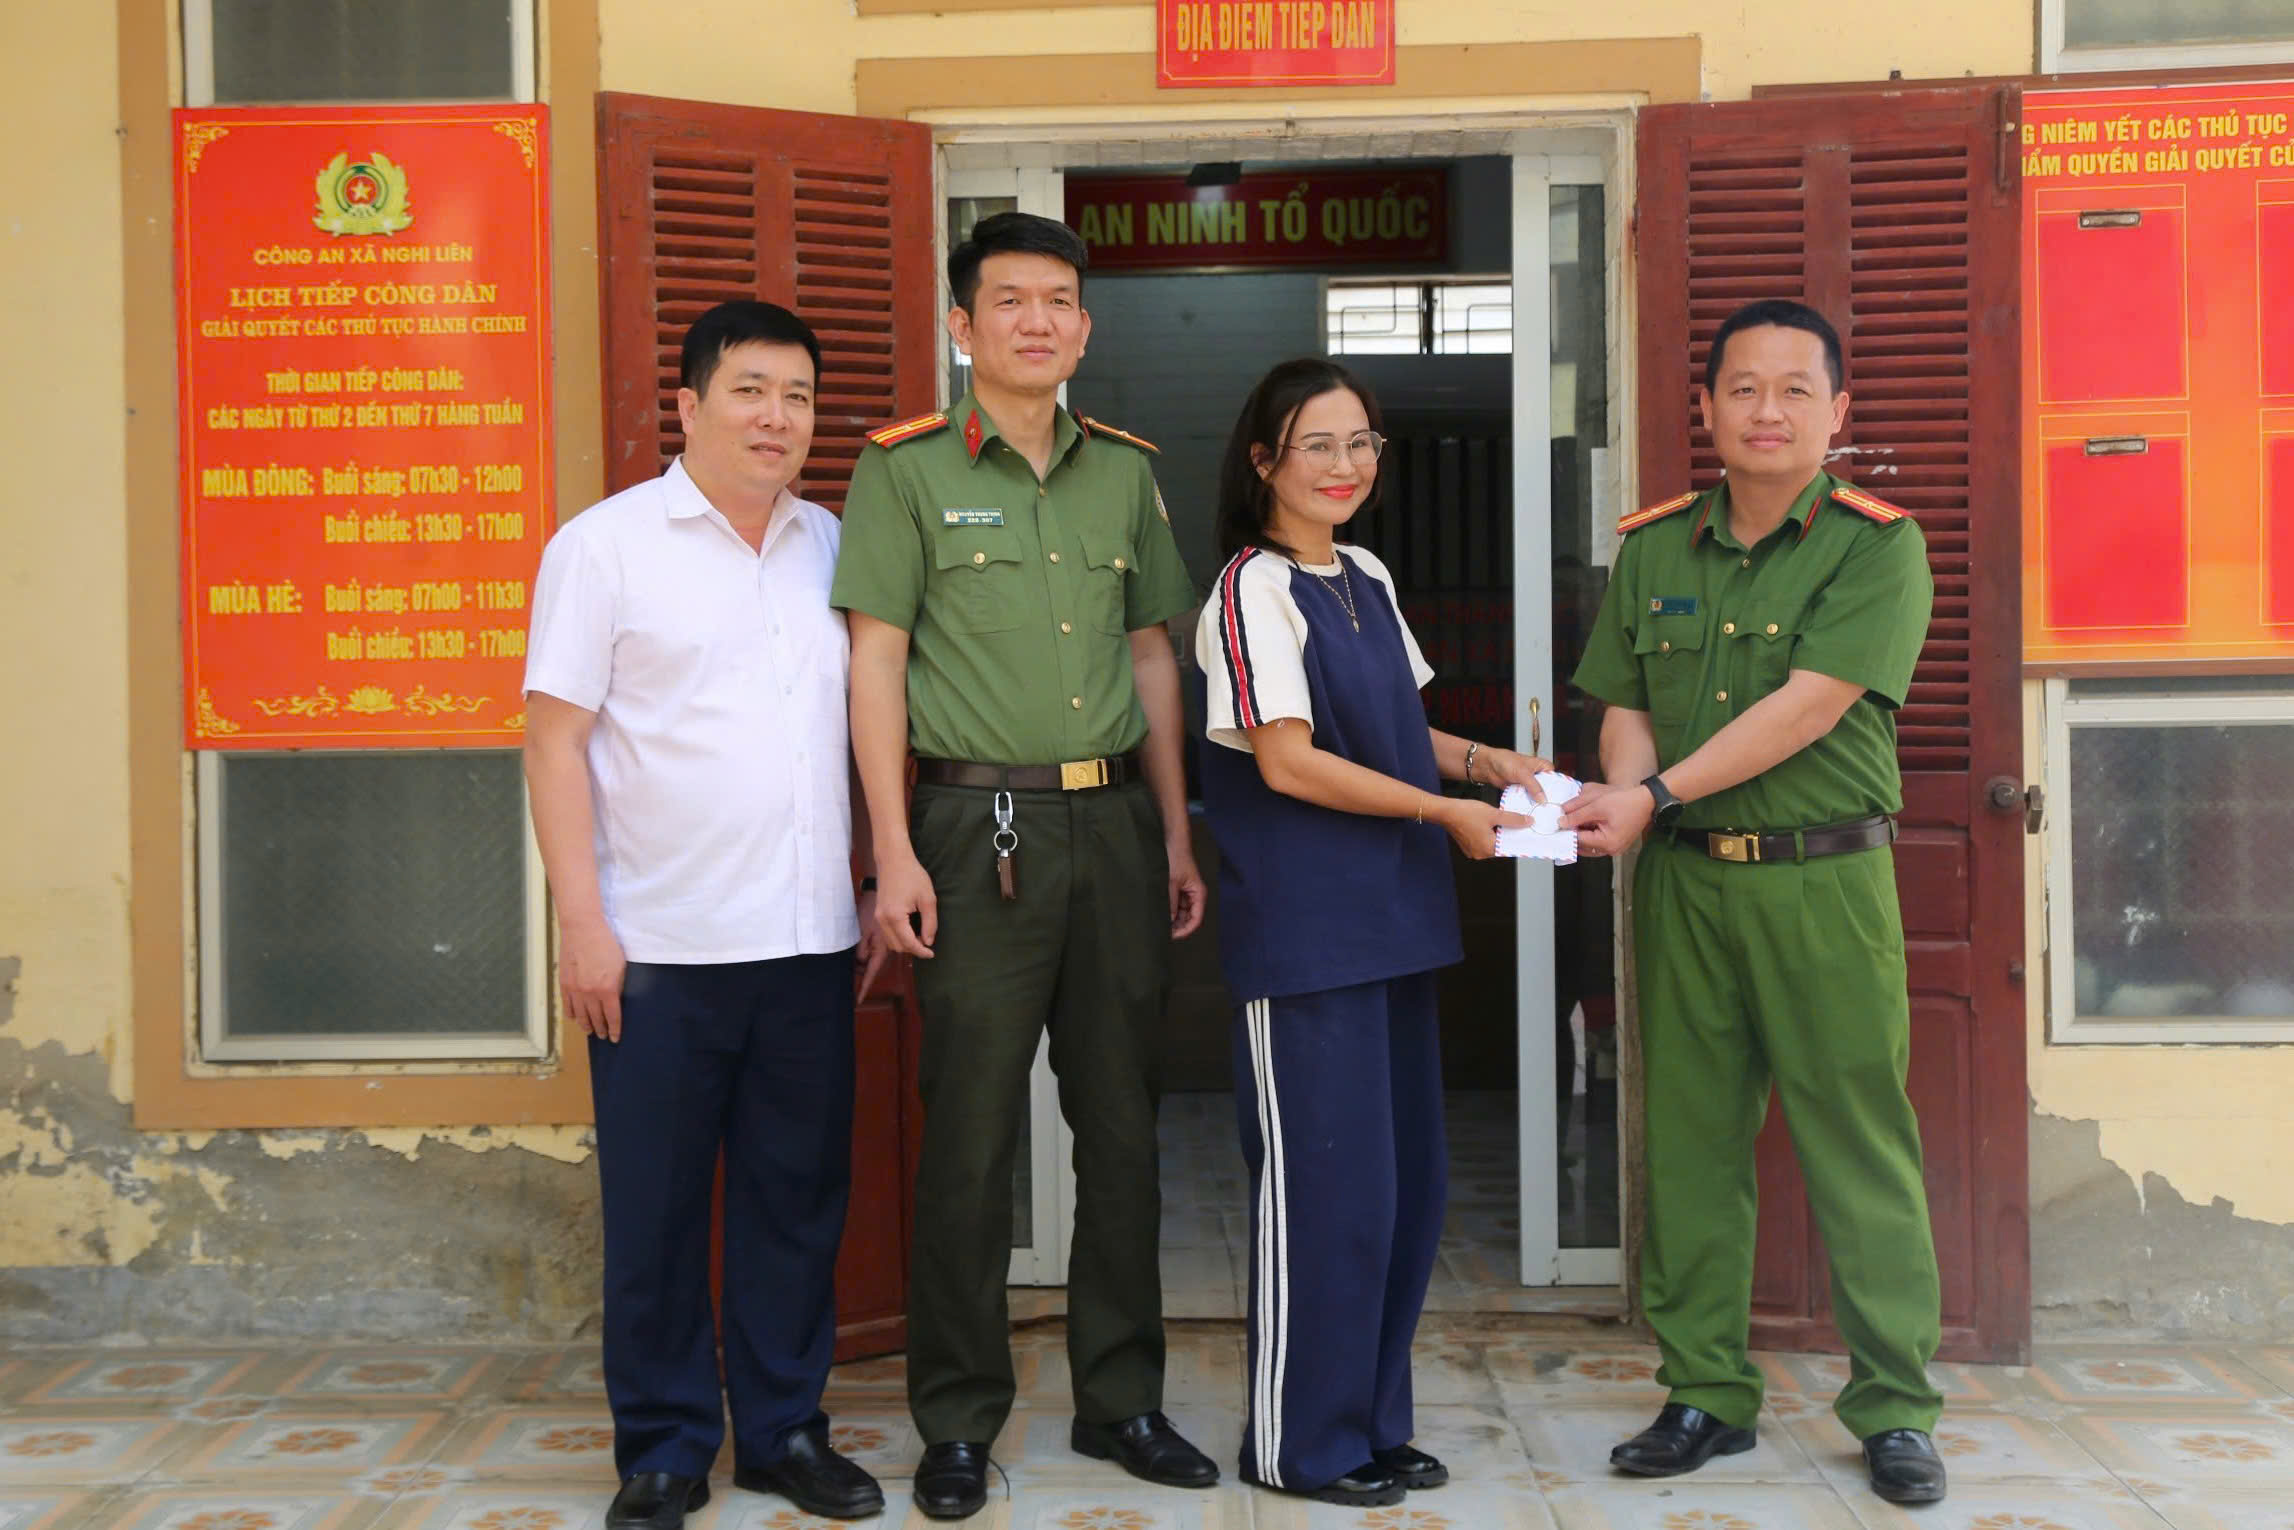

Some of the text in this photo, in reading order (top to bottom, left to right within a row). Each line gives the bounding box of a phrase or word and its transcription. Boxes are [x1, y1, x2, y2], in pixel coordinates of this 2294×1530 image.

[2042, 118, 2097, 144] NIÊM
[2104, 113, 2141, 142] YẾT
[2148, 114, 2192, 140] CÁC
[2198, 108, 2239, 137] THỦ
[2246, 113, 2287, 140] TỤC
[2145, 144, 2188, 173] GIẢI
[2195, 140, 2263, 172] QUYẾT
[1080, 182, 1428, 246] AN NINH TỔ QUỐC
[254, 243, 473, 265] CÔNG AN XÃ NGHI LIÊN
[231, 279, 497, 312] LỊCH TIẾP CÔNG DÂN
[202, 313, 527, 338] GIẢI QUYẾT CÁC THỦ TỤC HÀNH CHÍNH
[304, 372, 341, 392] GIAN
[347, 365, 378, 392] TIẾP
[382, 368, 424, 391] CÔNG
[208, 403, 239, 429] CÁC
[243, 404, 284, 428] NGÀY
[344, 406, 353, 427] 2
[425, 405, 433, 426] 7
[203, 464, 249, 496] MÙA
[323, 460, 359, 495] Buổi
[410, 465, 459, 493] 07h30
[475, 465, 523, 493] 12h00
[325, 508, 360, 543] Buổi
[416, 514, 463, 541] 13h30
[477, 513, 524, 540] 17h00
[209, 580, 261, 614] MÙA
[325, 577, 361, 612] Buổi
[412, 583, 461, 610] 07h00
[477, 582, 525, 609] 11h30
[327, 625, 363, 660] Buổi
[418, 631, 465, 659] 13h30
[480, 630, 526, 657] 17h00
